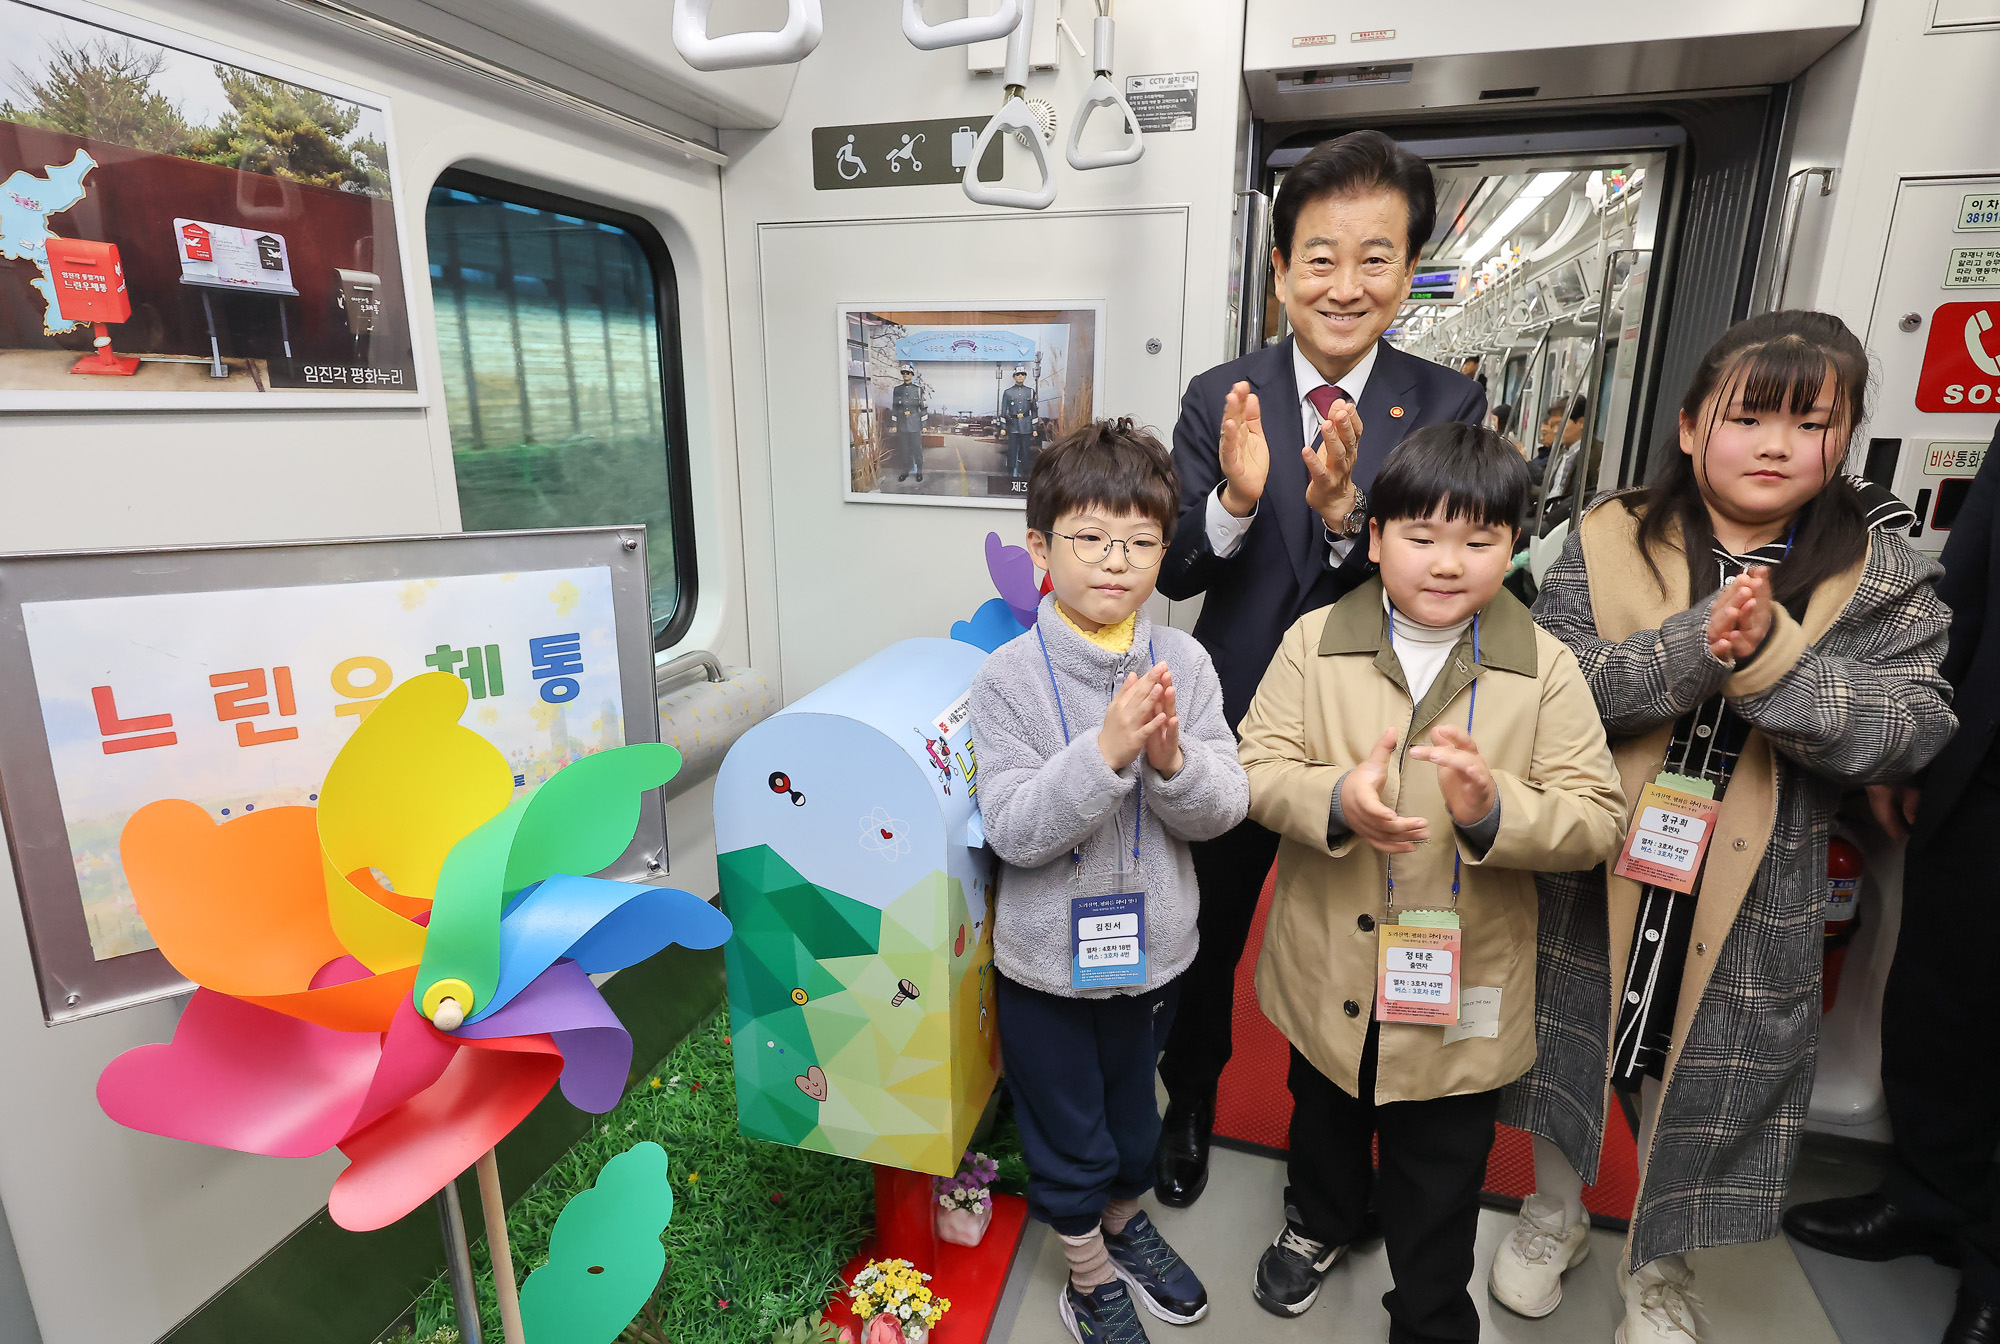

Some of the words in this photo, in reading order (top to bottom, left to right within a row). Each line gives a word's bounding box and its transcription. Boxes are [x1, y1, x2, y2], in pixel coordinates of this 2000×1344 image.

[1972, 200, 1983, 210] 이
[1966, 212, 2000, 223] 38191
[304, 366, 347, 384] 임진각
[350, 368, 403, 385] 평화누리
[1661, 813, 1688, 828] 정규희
[1662, 825, 1680, 834] 출연자
[1096, 922, 1121, 932] 김진서
[1405, 951, 1433, 961] 정태준
